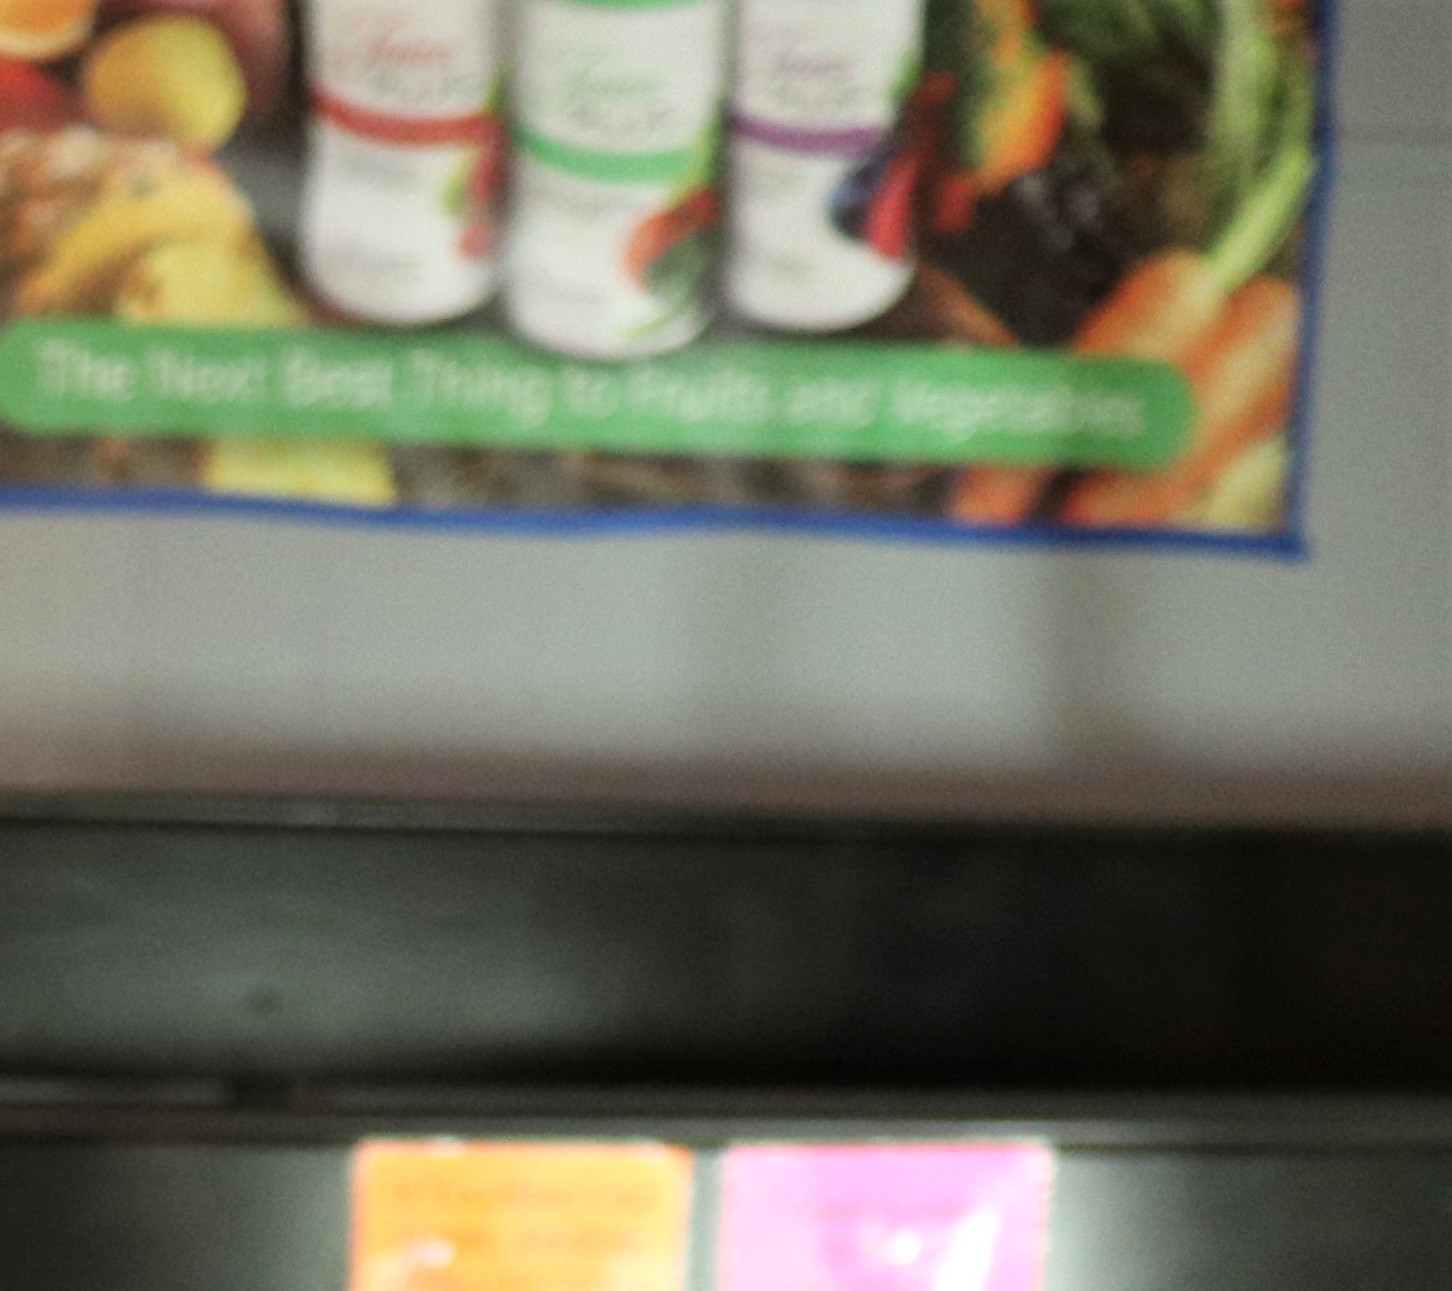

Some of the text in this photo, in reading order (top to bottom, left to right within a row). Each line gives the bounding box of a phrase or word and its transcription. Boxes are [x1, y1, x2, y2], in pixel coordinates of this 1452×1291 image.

[38, 340, 133, 399] The
[147, 344, 269, 406] Next
[281, 345, 395, 411] Best
[409, 347, 553, 430] Thing
[560, 365, 621, 418] to
[629, 366, 772, 424] Fruits
[784, 377, 876, 428] and
